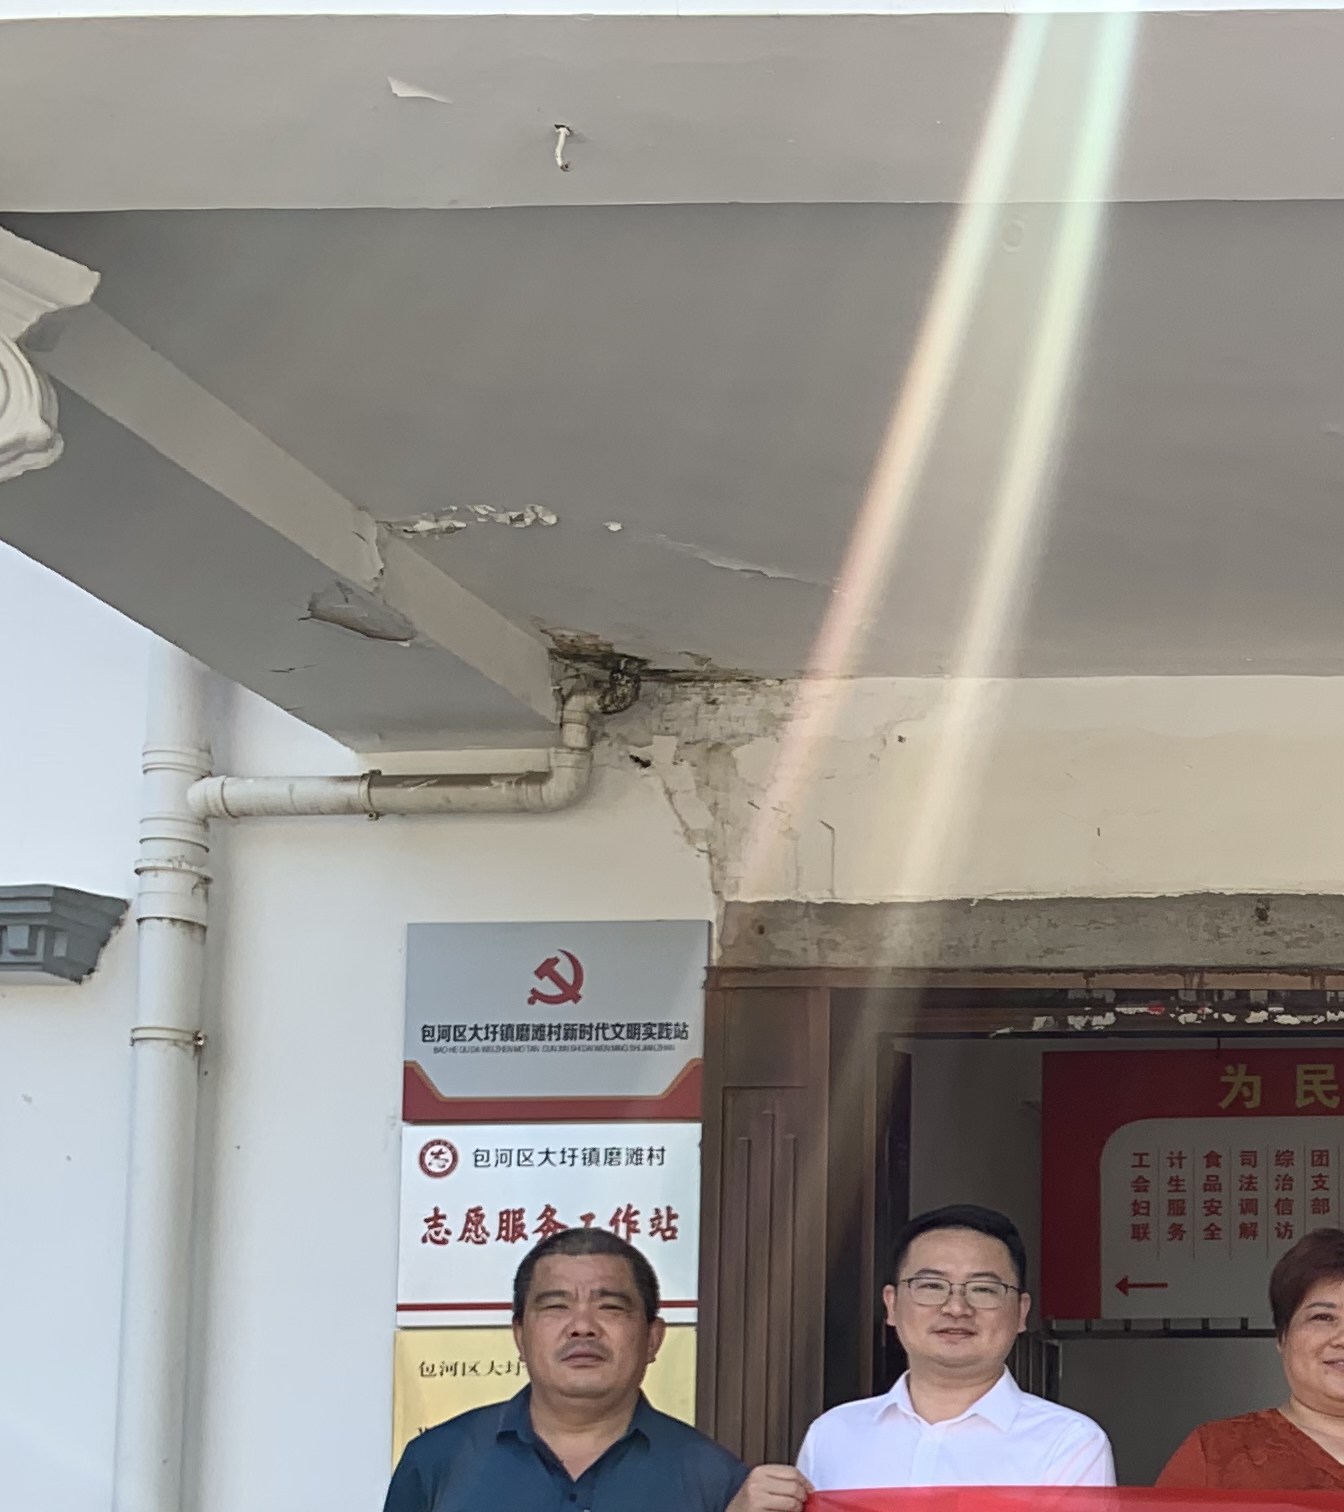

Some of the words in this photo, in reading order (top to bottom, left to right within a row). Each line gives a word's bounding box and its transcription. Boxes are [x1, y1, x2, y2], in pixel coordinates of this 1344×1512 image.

[420, 1022, 690, 1043] 包河区大圩镇磨滩村新时代文明实践站
[472, 1146, 666, 1168] 包河区大圩镇磨滩村
[1131, 1152, 1150, 1241] 工会妇联
[1166, 1151, 1187, 1241] 计生服务
[1202, 1150, 1223, 1240] 食品安全
[1239, 1151, 1259, 1240] 司法调解
[1274, 1149, 1295, 1240] 综治信访
[1310, 1150, 1331, 1215] 团支部
[420, 1203, 680, 1246] 志愿服务工作站
